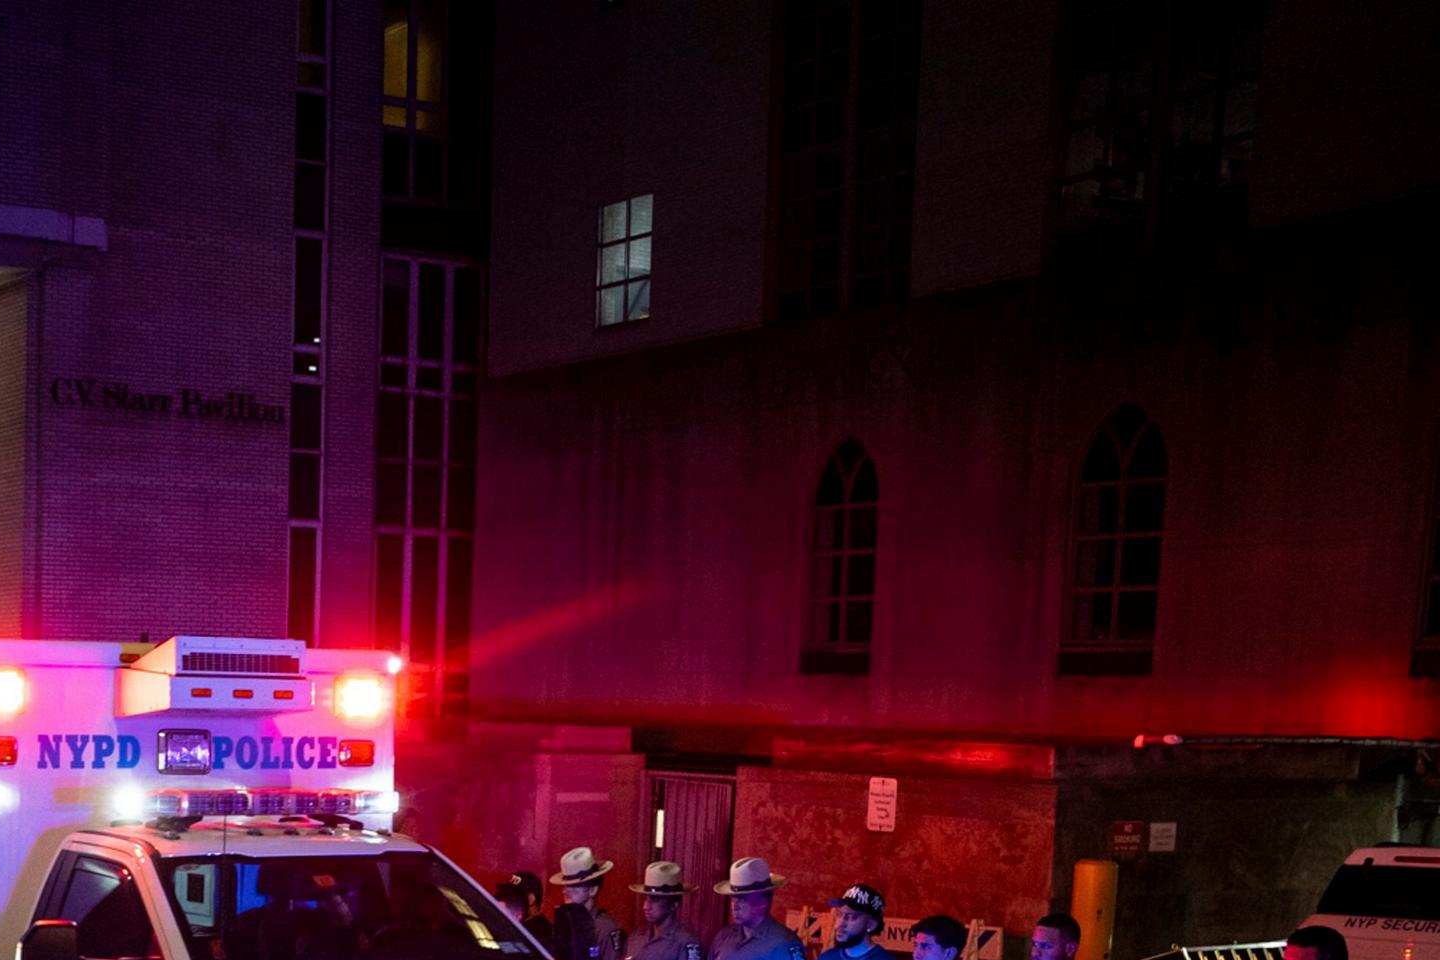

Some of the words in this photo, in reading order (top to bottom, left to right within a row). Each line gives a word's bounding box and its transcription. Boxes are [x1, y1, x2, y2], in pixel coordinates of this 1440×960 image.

[101, 382, 174, 413] Starr
[180, 387, 286, 424] Pavilion
[37, 734, 142, 770] NYPD
[211, 734, 338, 770] POLICE
[1344, 917, 1378, 929] NYP
[1381, 918, 1440, 935] SECUR
